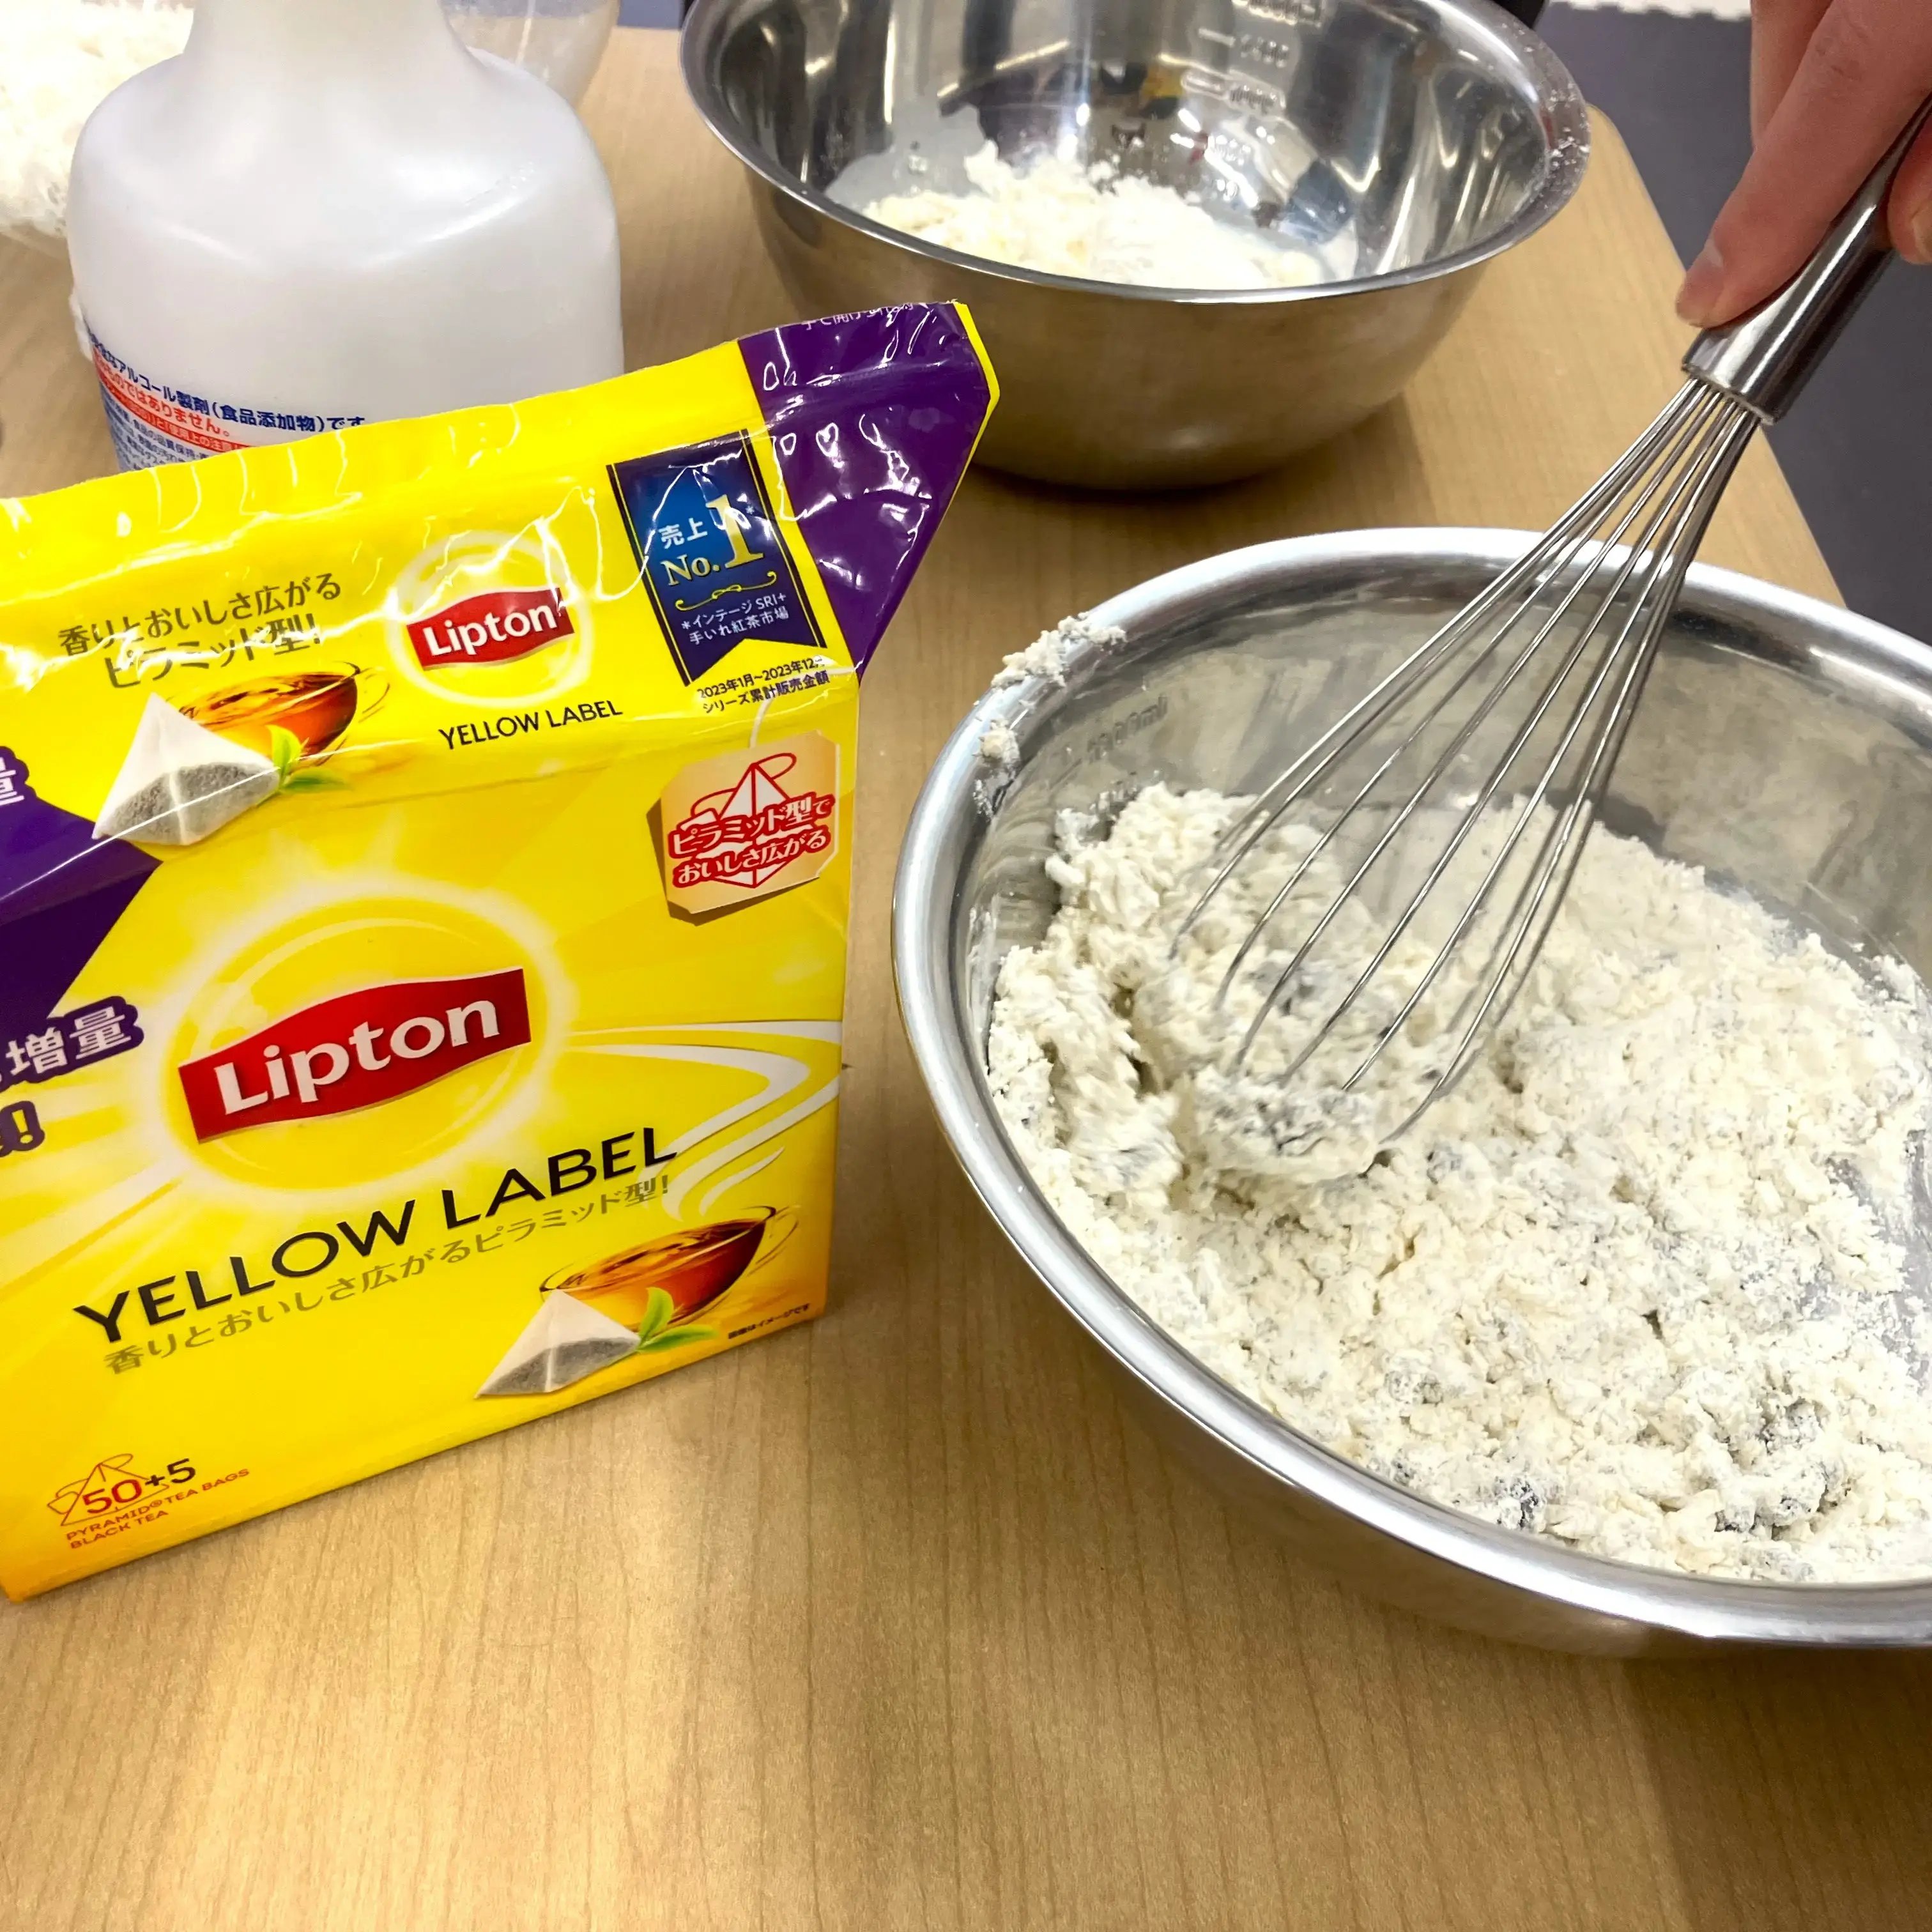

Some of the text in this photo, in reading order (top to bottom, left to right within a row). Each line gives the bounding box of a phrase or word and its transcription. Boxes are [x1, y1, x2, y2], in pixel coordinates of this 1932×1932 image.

[658, 518, 708, 549] 売上
[57, 572, 342, 657] 香りとおいしさ広がる
[422, 604, 558, 656] Lipton
[689, 606, 790, 646] 手いれ紅茶市場
[703, 670, 831, 714] シリーズ累計販売金額
[438, 700, 623, 750] YELLOW LABEL
[673, 796, 832, 855] ピラミッド型で
[678, 832, 827, 885] おいしさ広がる
[214, 999, 499, 1114] Lipton
[73, 1127, 677, 1343] YELLOW LABEL
[164, 1489, 199, 1504] TEA
[202, 1468, 250, 1492] BAGS
[70, 1510, 169, 1549] BLACK TEA
